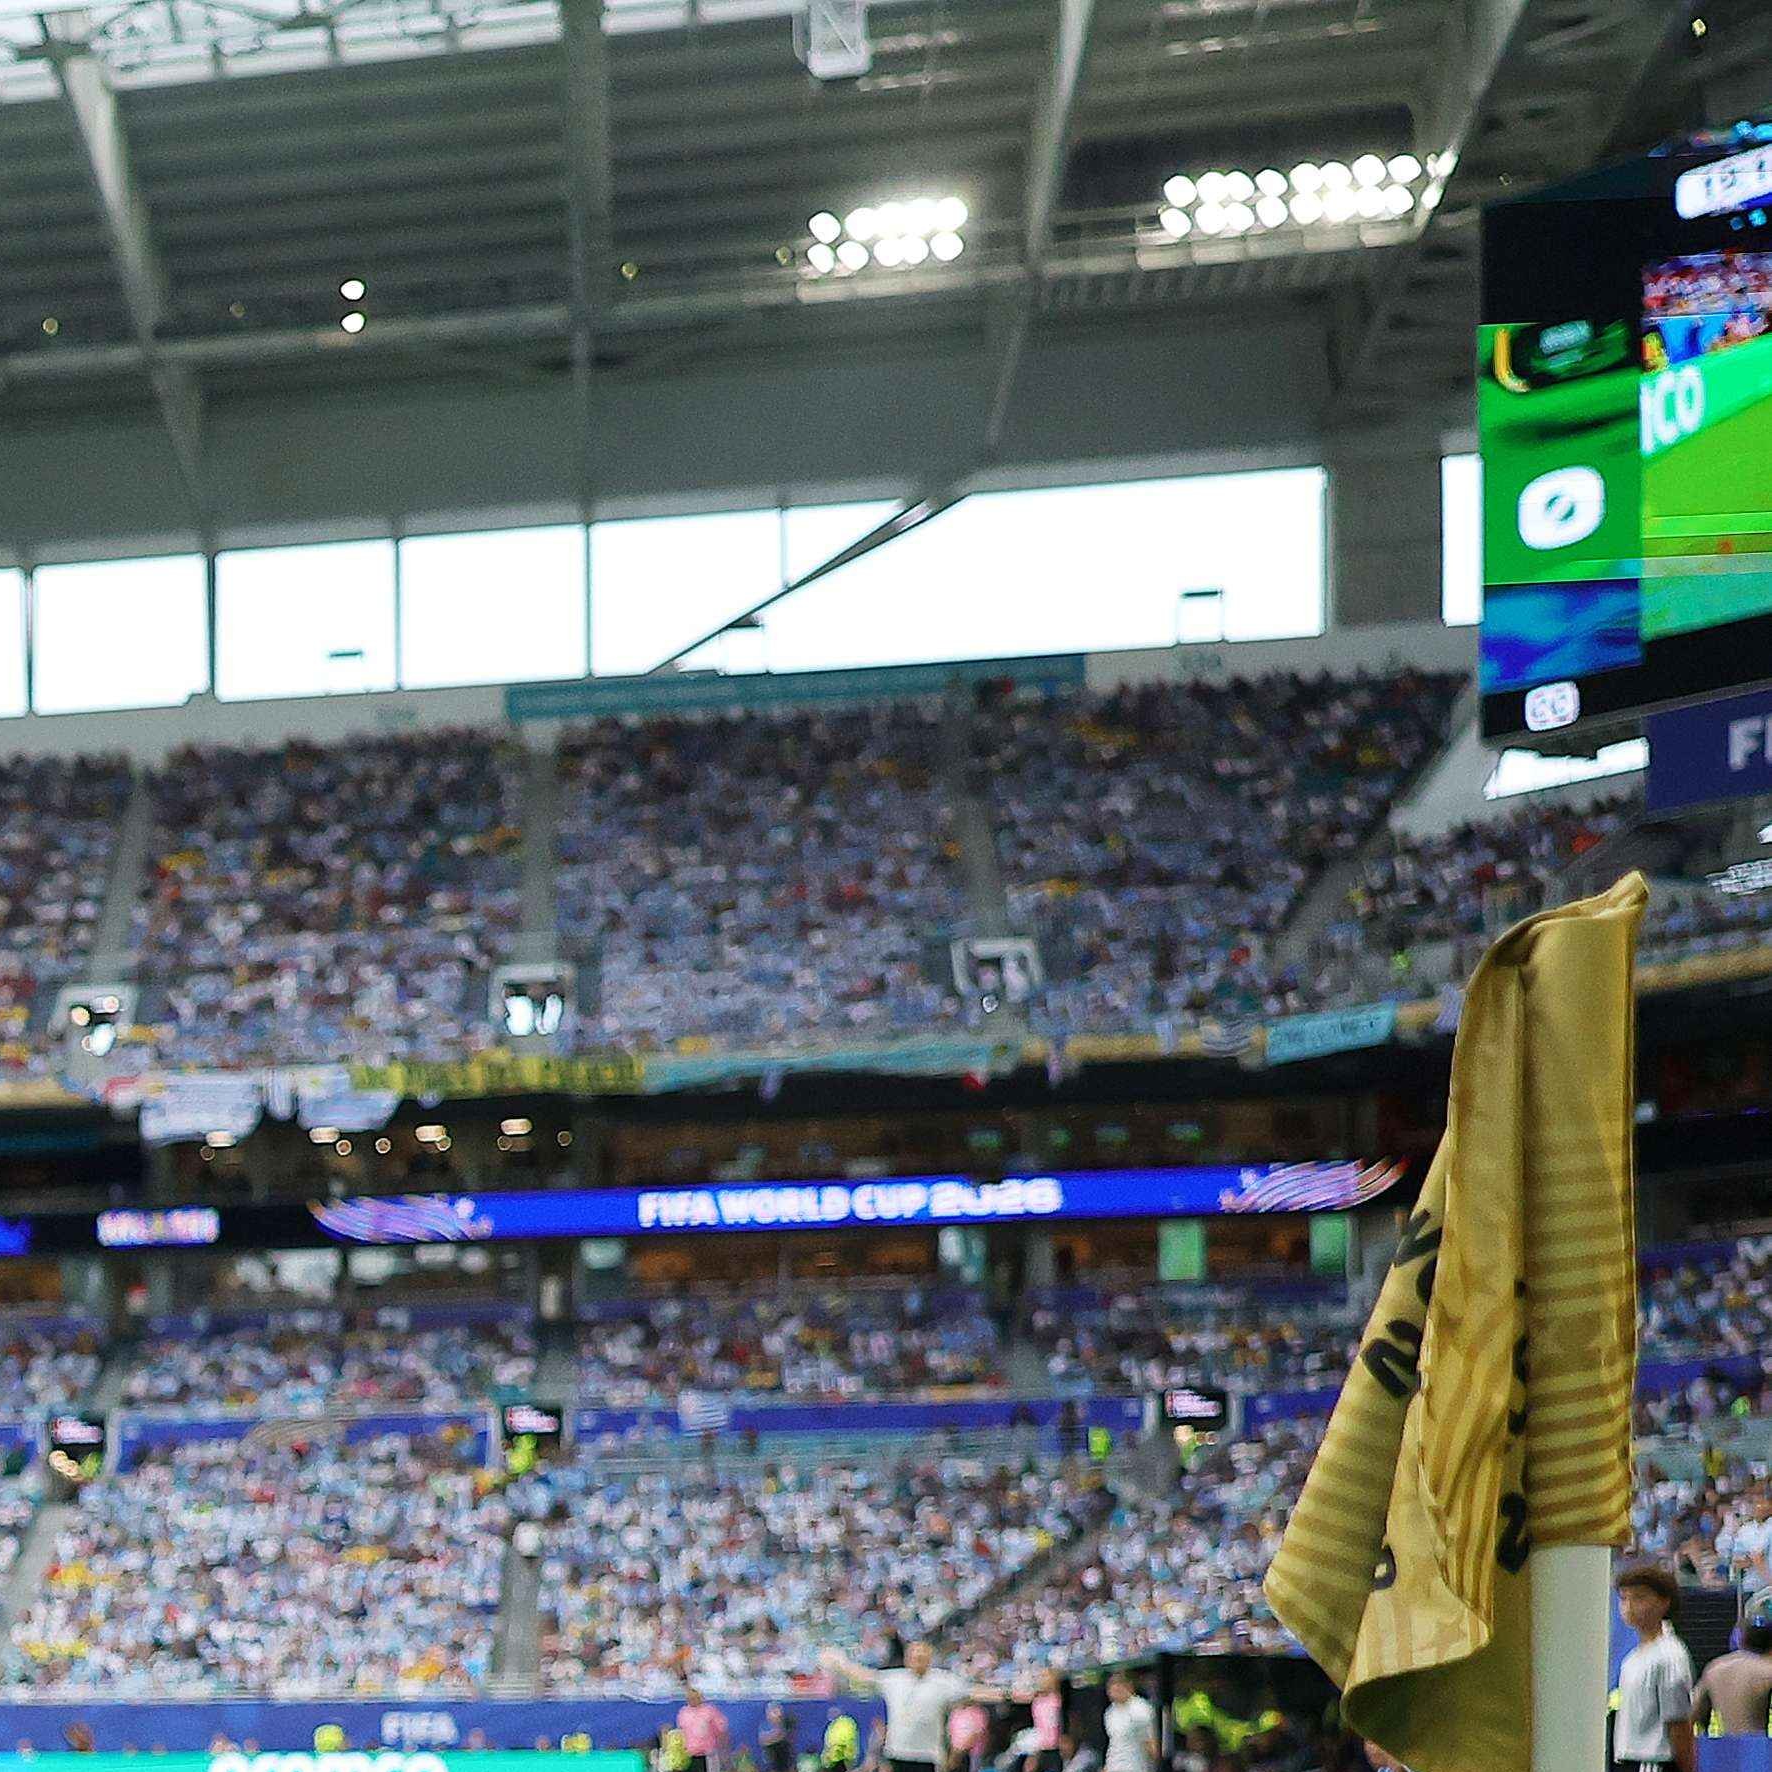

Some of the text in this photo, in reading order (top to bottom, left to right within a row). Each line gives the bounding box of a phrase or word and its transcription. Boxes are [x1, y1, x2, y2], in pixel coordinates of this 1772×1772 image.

[637, 1190, 718, 1228] FIFA
[718, 1185, 851, 1225] WORLD
[851, 1182, 928, 1221] CUP
